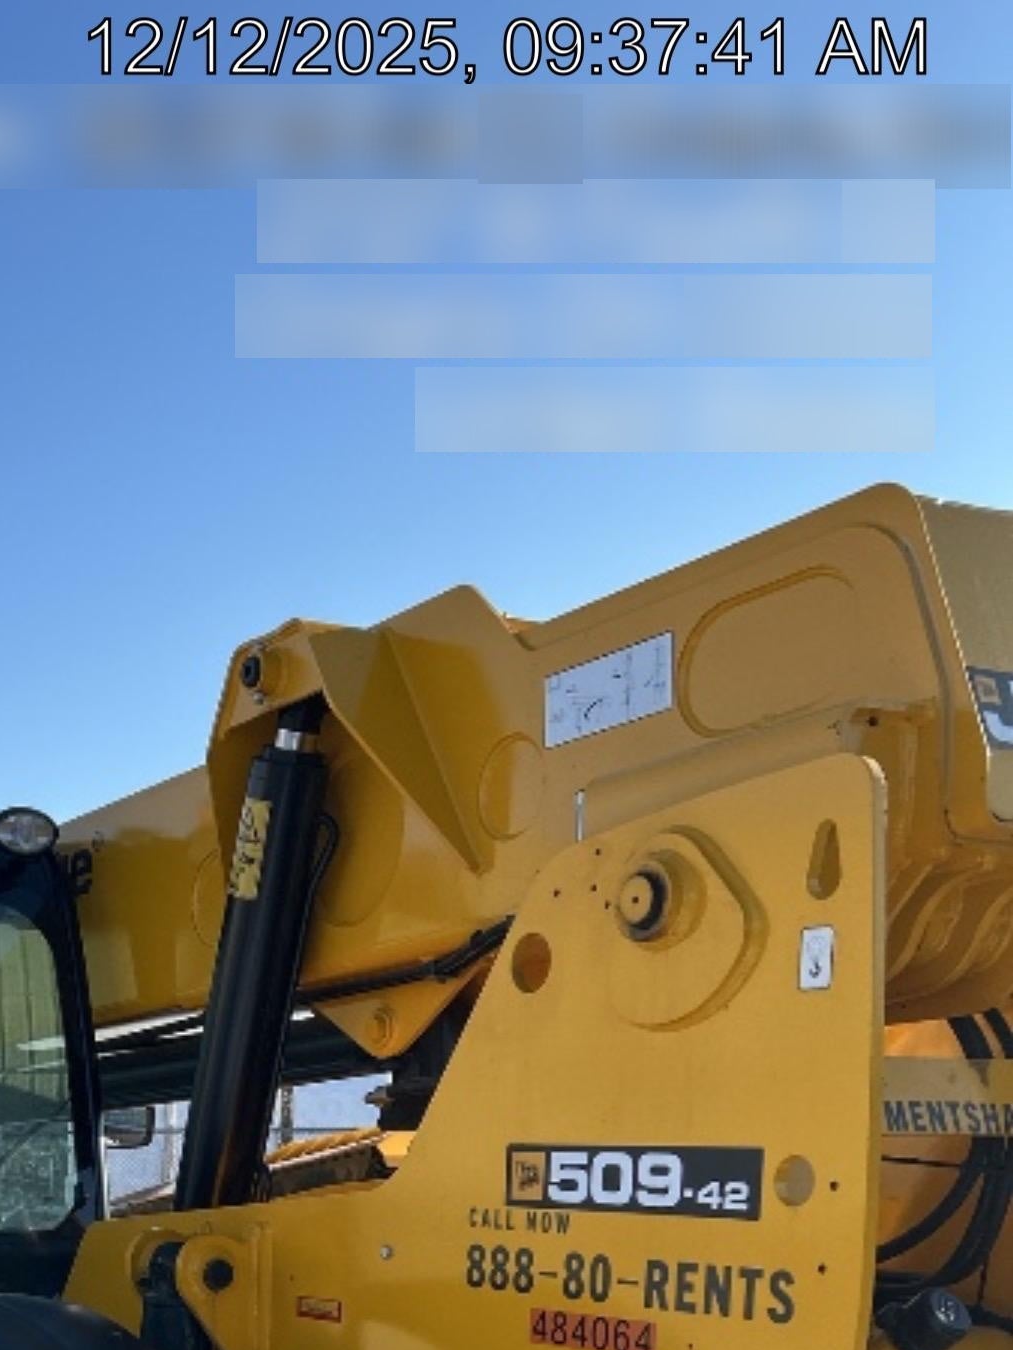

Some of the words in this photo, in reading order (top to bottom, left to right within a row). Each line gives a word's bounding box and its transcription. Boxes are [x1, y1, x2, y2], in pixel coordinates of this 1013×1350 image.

[469, 1208, 515, 1231] CALL
[526, 1211, 570, 1235] NOW
[466, 1244, 795, 1324] 888-80-RENTS
